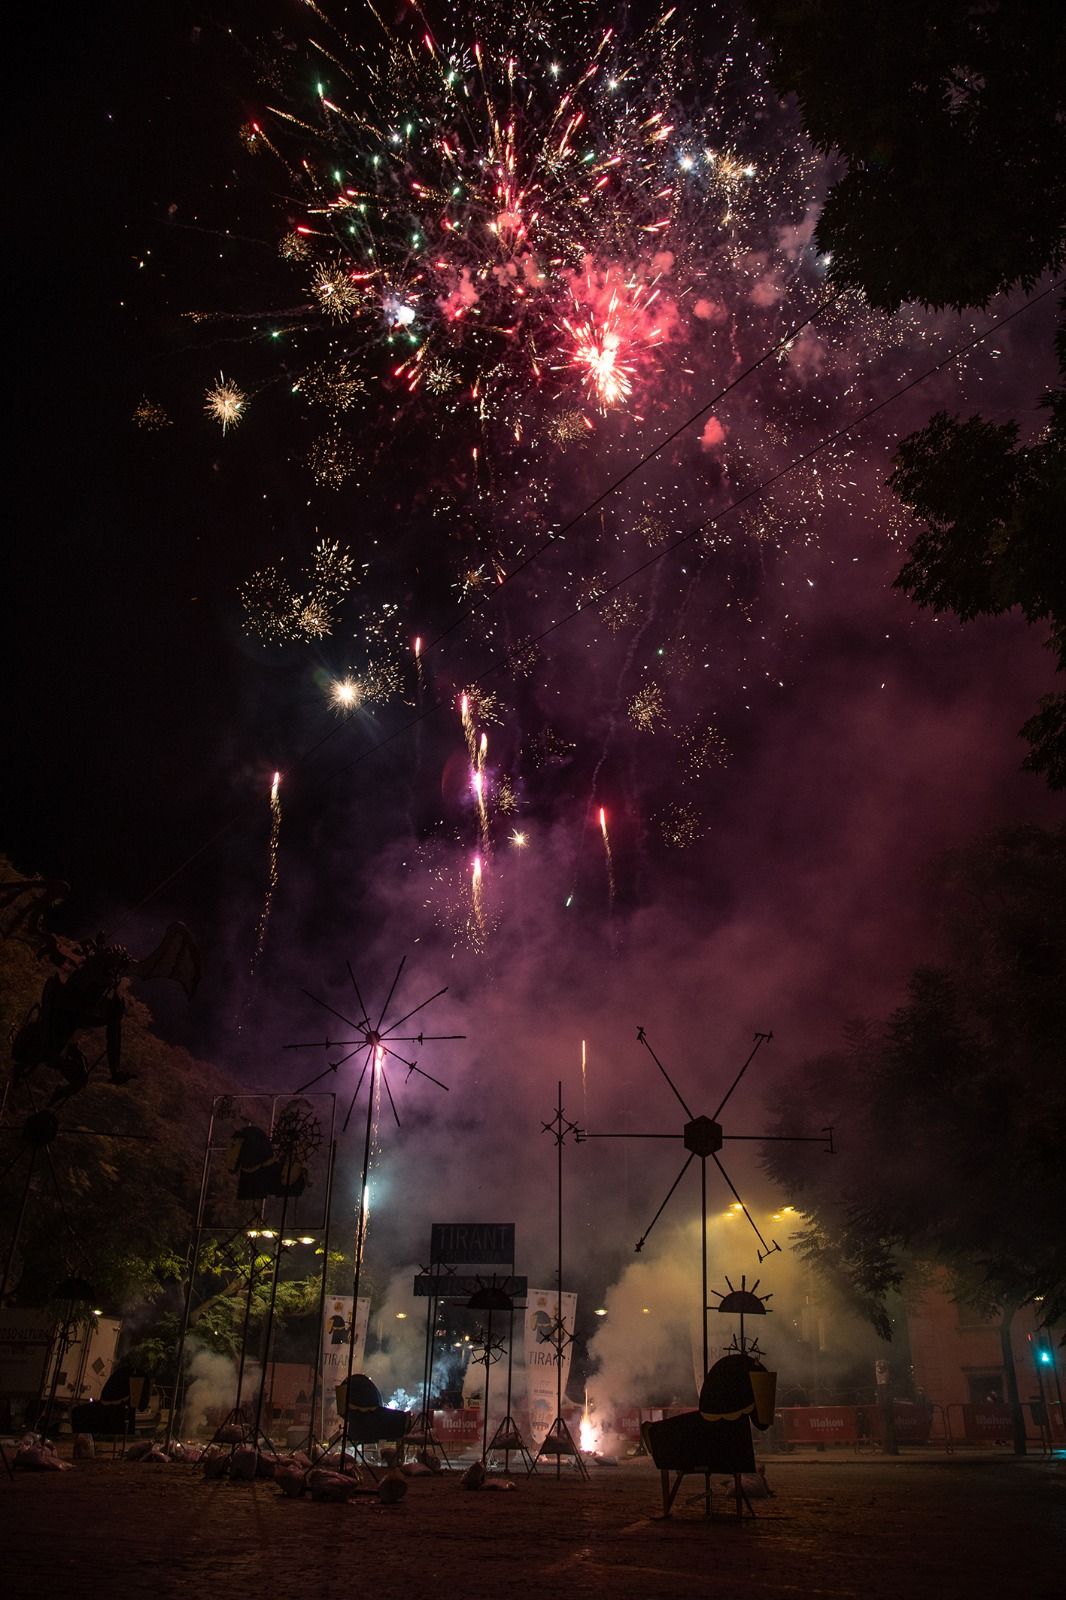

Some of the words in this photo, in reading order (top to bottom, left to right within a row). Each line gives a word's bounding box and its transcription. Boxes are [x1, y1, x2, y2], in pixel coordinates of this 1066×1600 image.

[438, 1226, 508, 1249] TIRANT
[443, 1418, 477, 1429] Mahou
[809, 1417, 844, 1429] Mahou
